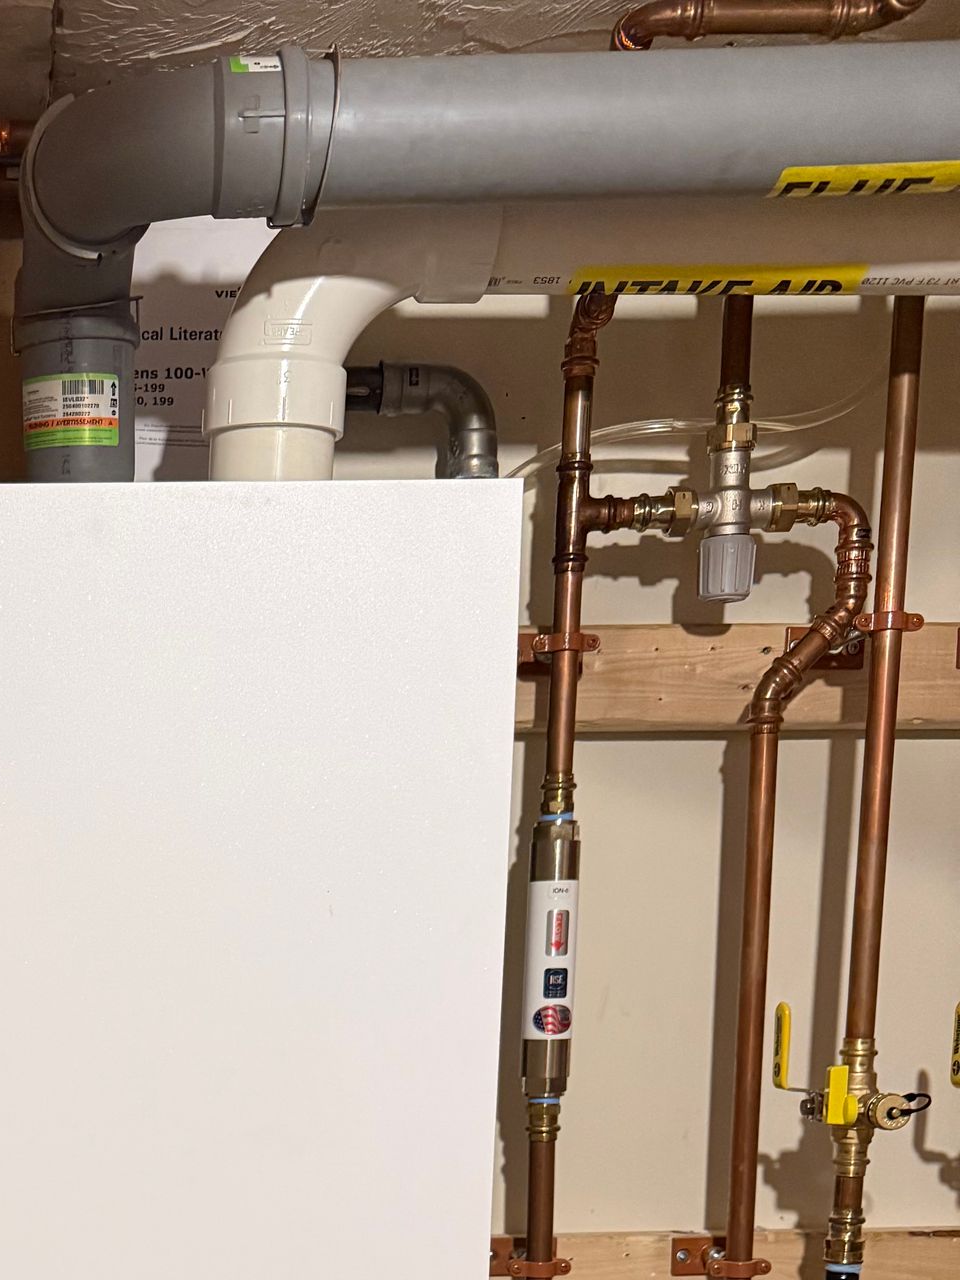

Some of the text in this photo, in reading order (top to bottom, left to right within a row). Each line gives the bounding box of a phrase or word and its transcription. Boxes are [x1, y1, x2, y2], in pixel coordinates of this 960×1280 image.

[533, 276, 561, 285] 1853
[170, 326, 223, 341] Literat
[152, 396, 174, 406] 199
